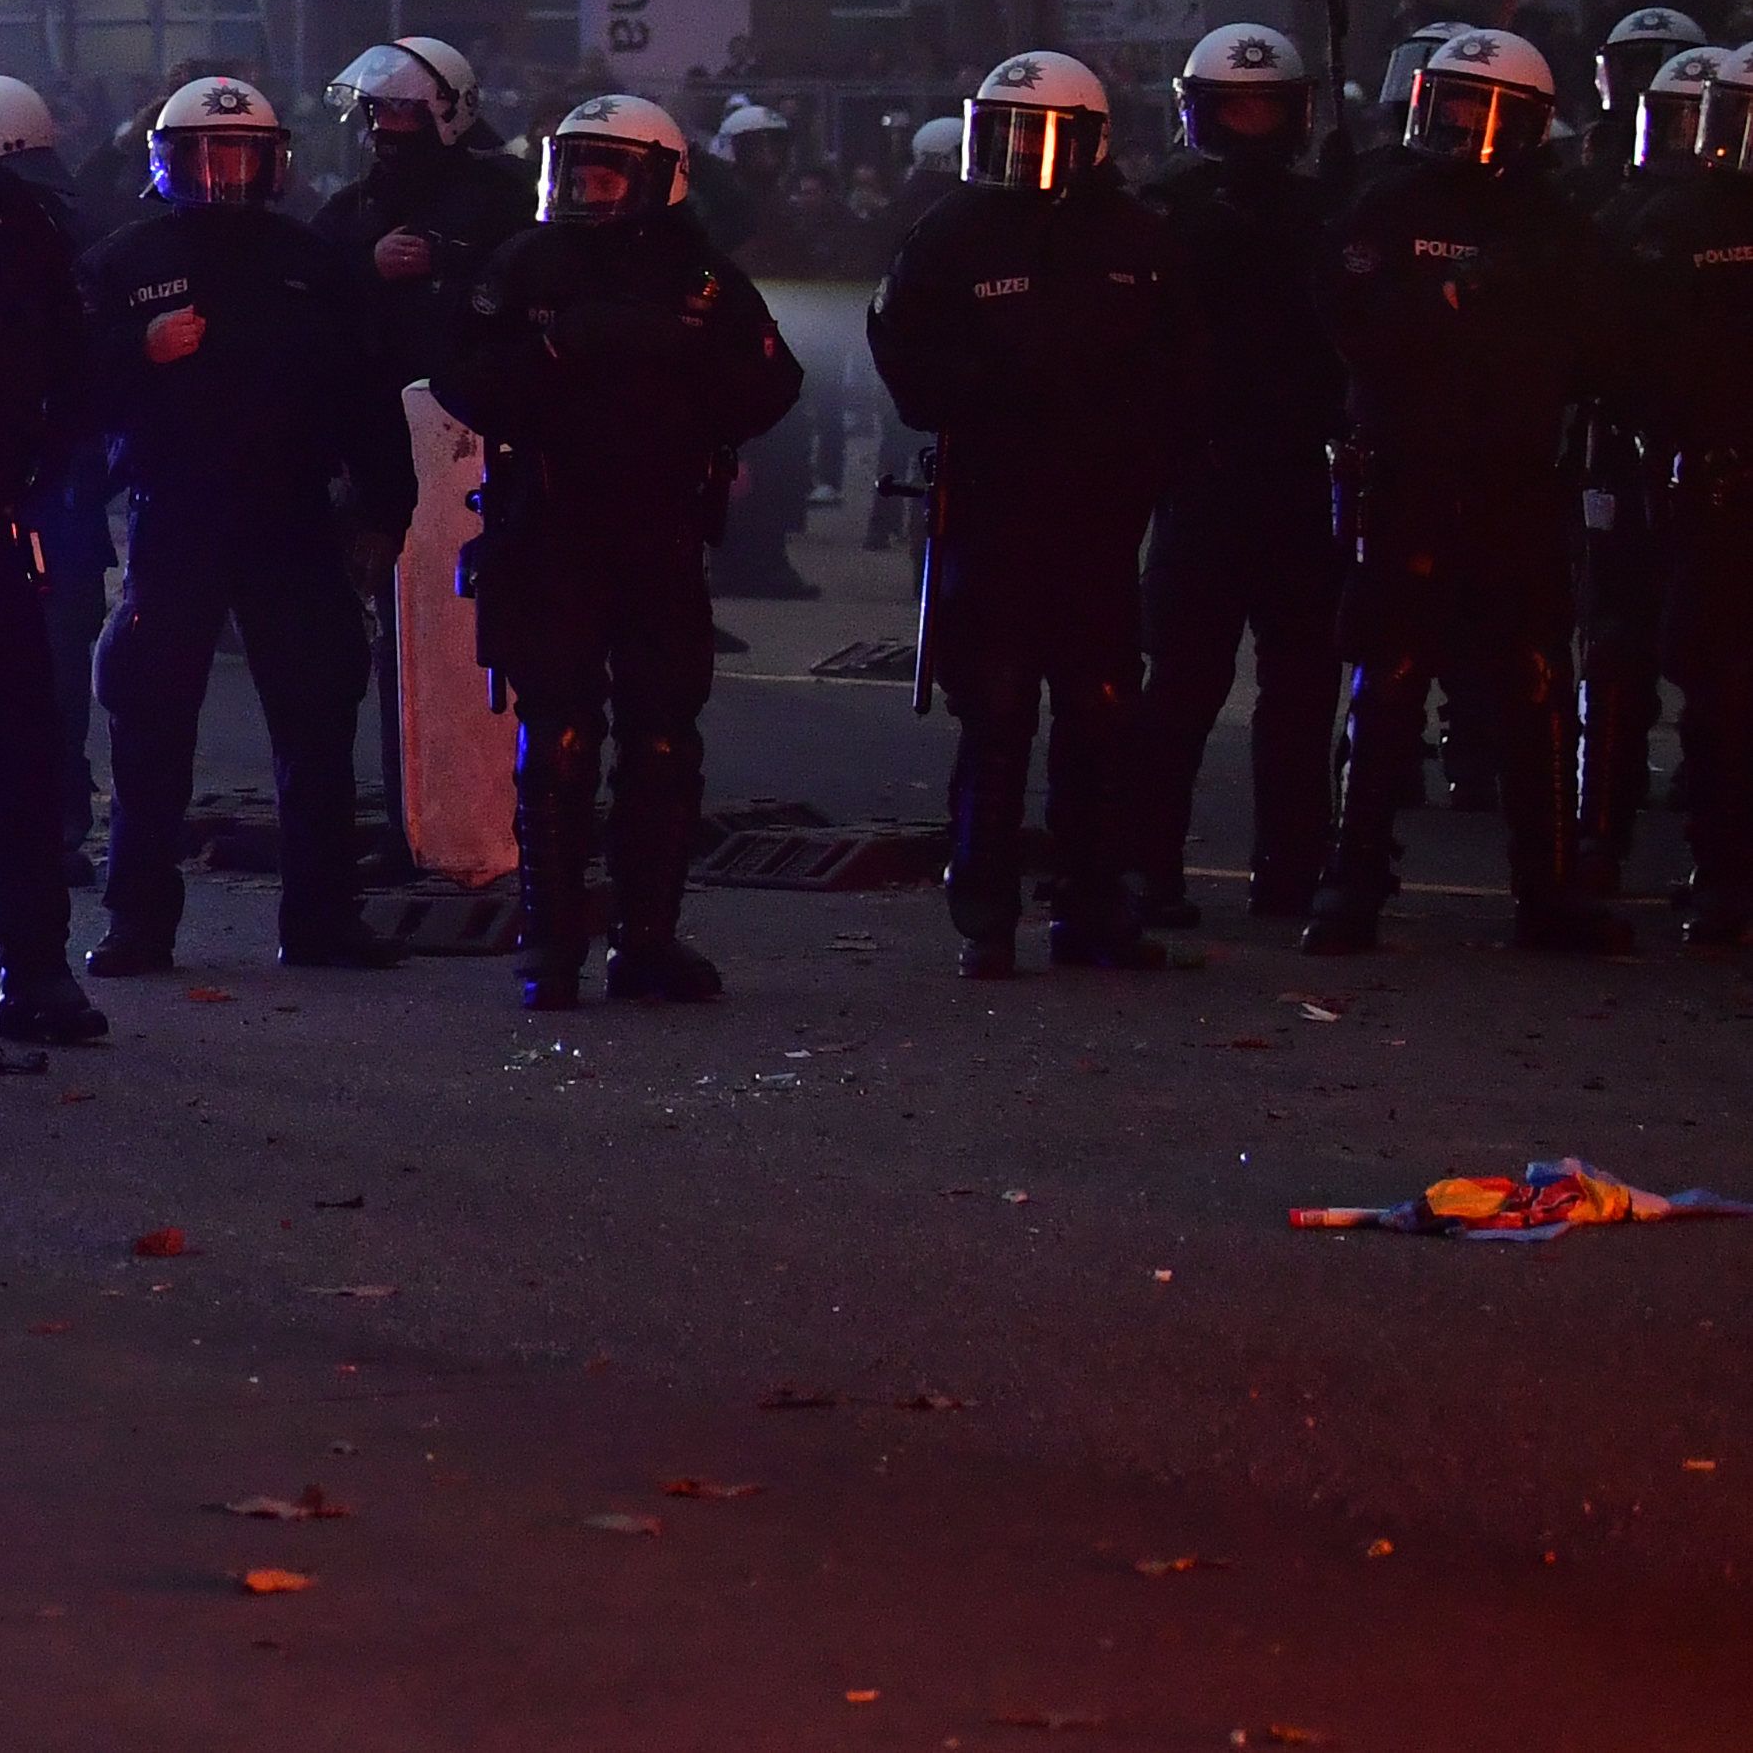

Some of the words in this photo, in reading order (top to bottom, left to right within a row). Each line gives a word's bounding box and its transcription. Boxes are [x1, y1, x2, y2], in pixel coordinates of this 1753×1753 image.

[1415, 239, 1479, 260] POLIZE
[1693, 246, 1753, 268] POLIZE
[974, 276, 1030, 298] OLIZEI
